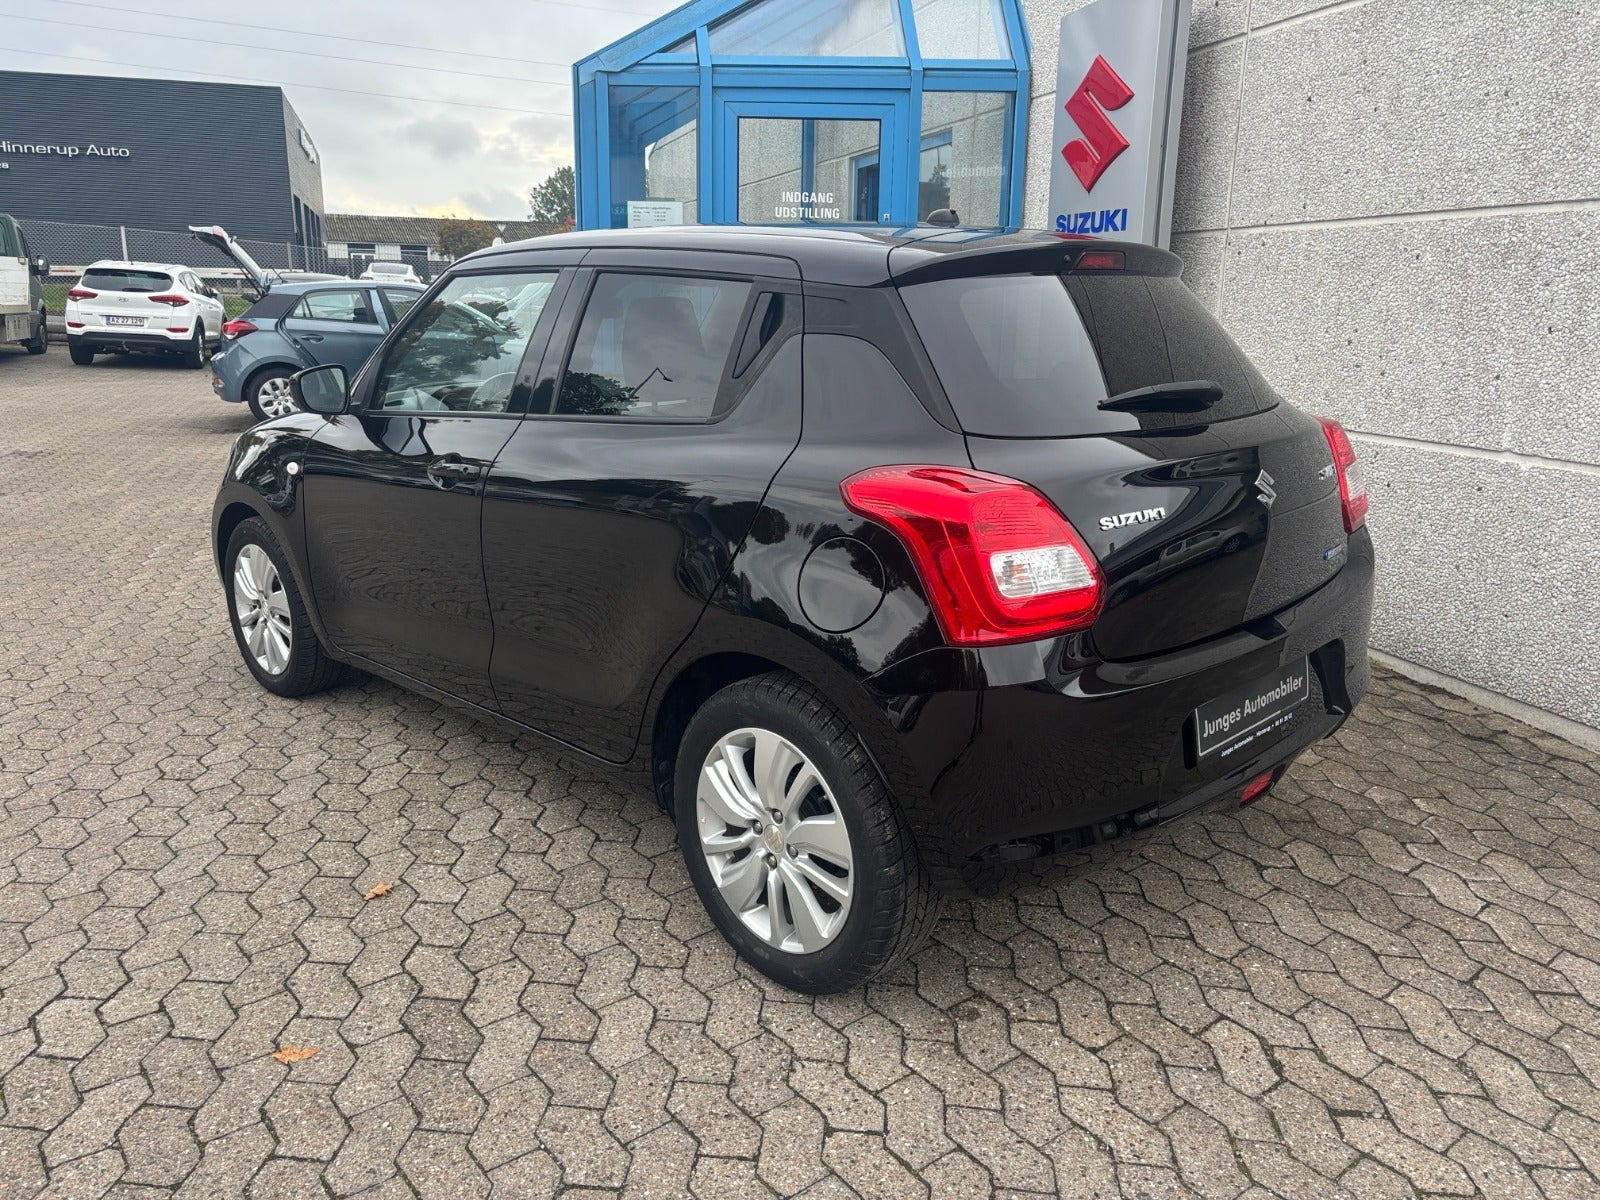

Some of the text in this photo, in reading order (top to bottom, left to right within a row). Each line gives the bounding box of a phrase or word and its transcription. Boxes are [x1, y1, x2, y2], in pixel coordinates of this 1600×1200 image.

[86, 144, 130, 157] Auto
[782, 191, 834, 204] INDGANG
[775, 206, 840, 219] UDSTILLING
[1056, 208, 1128, 234] SUZUKI
[1099, 506, 1166, 531] SUZUKI
[1203, 708, 1242, 738] Junges
[1243, 676, 1303, 717] Automobiler
